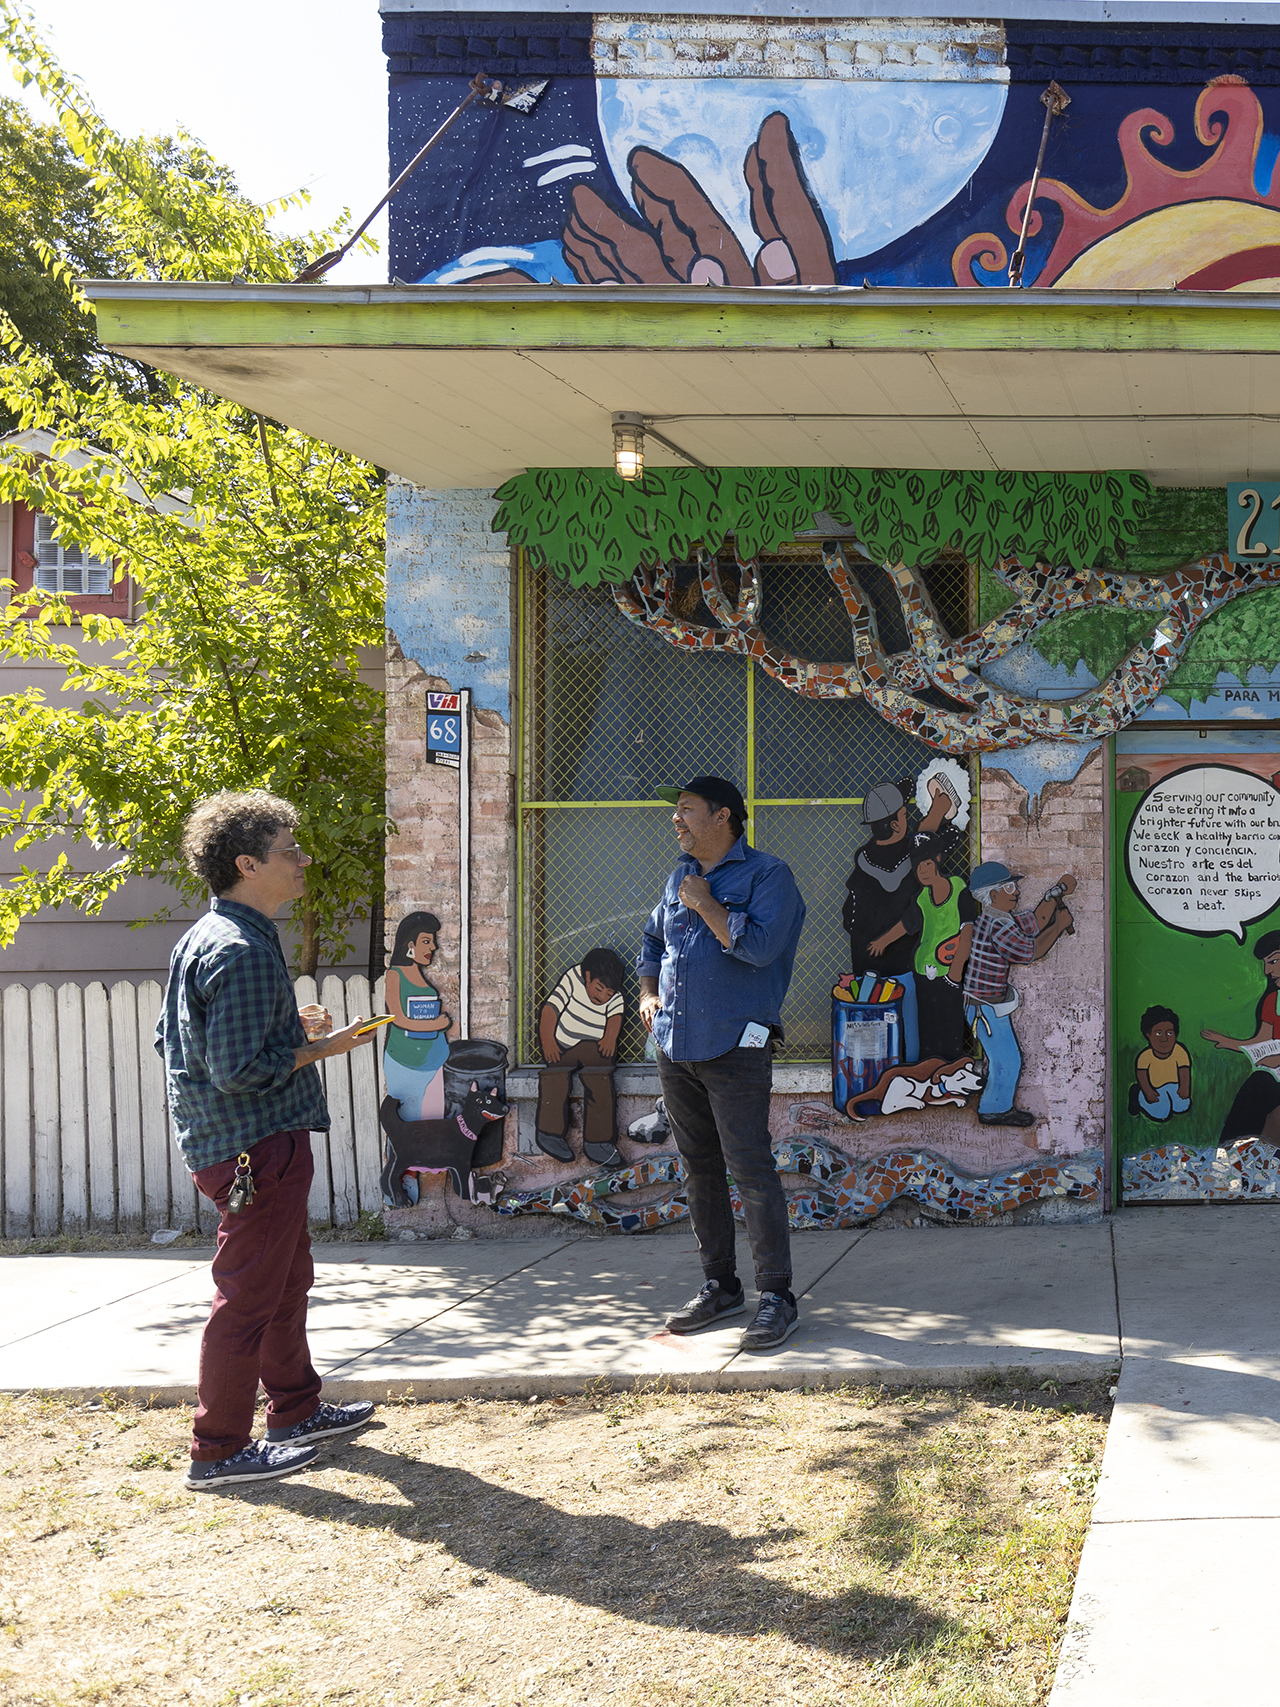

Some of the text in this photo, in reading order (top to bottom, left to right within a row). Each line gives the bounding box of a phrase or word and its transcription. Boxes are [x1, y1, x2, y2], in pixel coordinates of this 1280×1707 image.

[1225, 690, 1260, 701] PARA
[430, 718, 457, 744] 68
[1152, 791, 1275, 807] Serving our community
[1145, 803, 1163, 812] and
[1168, 805, 1214, 819] steering
[1217, 805, 1226, 815] it
[1249, 807, 1255, 815] a
[1139, 815, 1186, 830] brighter
[1187, 818, 1222, 828] future
[1224, 819, 1246, 828] with
[1133, 829, 1151, 839] We
[1185, 832, 1193, 840] a
[1195, 832, 1232, 846] healthy
[1235, 832, 1266, 840] barrio
[1132, 844, 1180, 852] corazon
[1185, 847, 1191, 857] y
[1139, 856, 1253, 870] Nuestro arte es del
[1197, 871, 1219, 882] and
[1225, 871, 1243, 882] the
[1200, 888, 1228, 896] never
[1234, 888, 1262, 900] skips
[1182, 899, 1226, 910] a beat.
